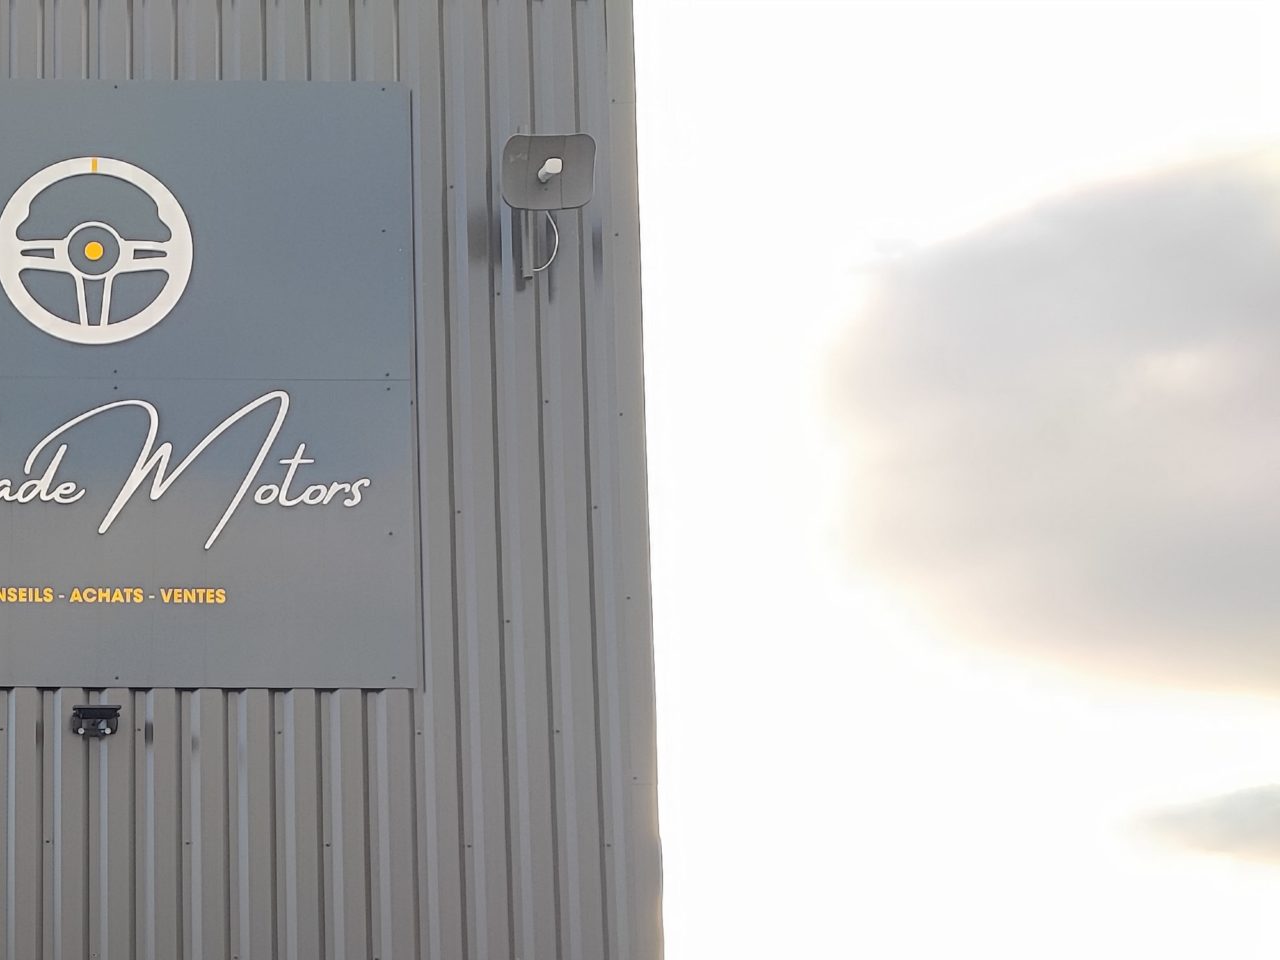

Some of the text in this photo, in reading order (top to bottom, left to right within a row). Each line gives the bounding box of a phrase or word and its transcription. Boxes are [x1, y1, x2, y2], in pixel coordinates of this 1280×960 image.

[23, 389, 372, 550] Motors
[69, 587, 144, 603] ACHATS
[160, 588, 227, 604] VENTES
